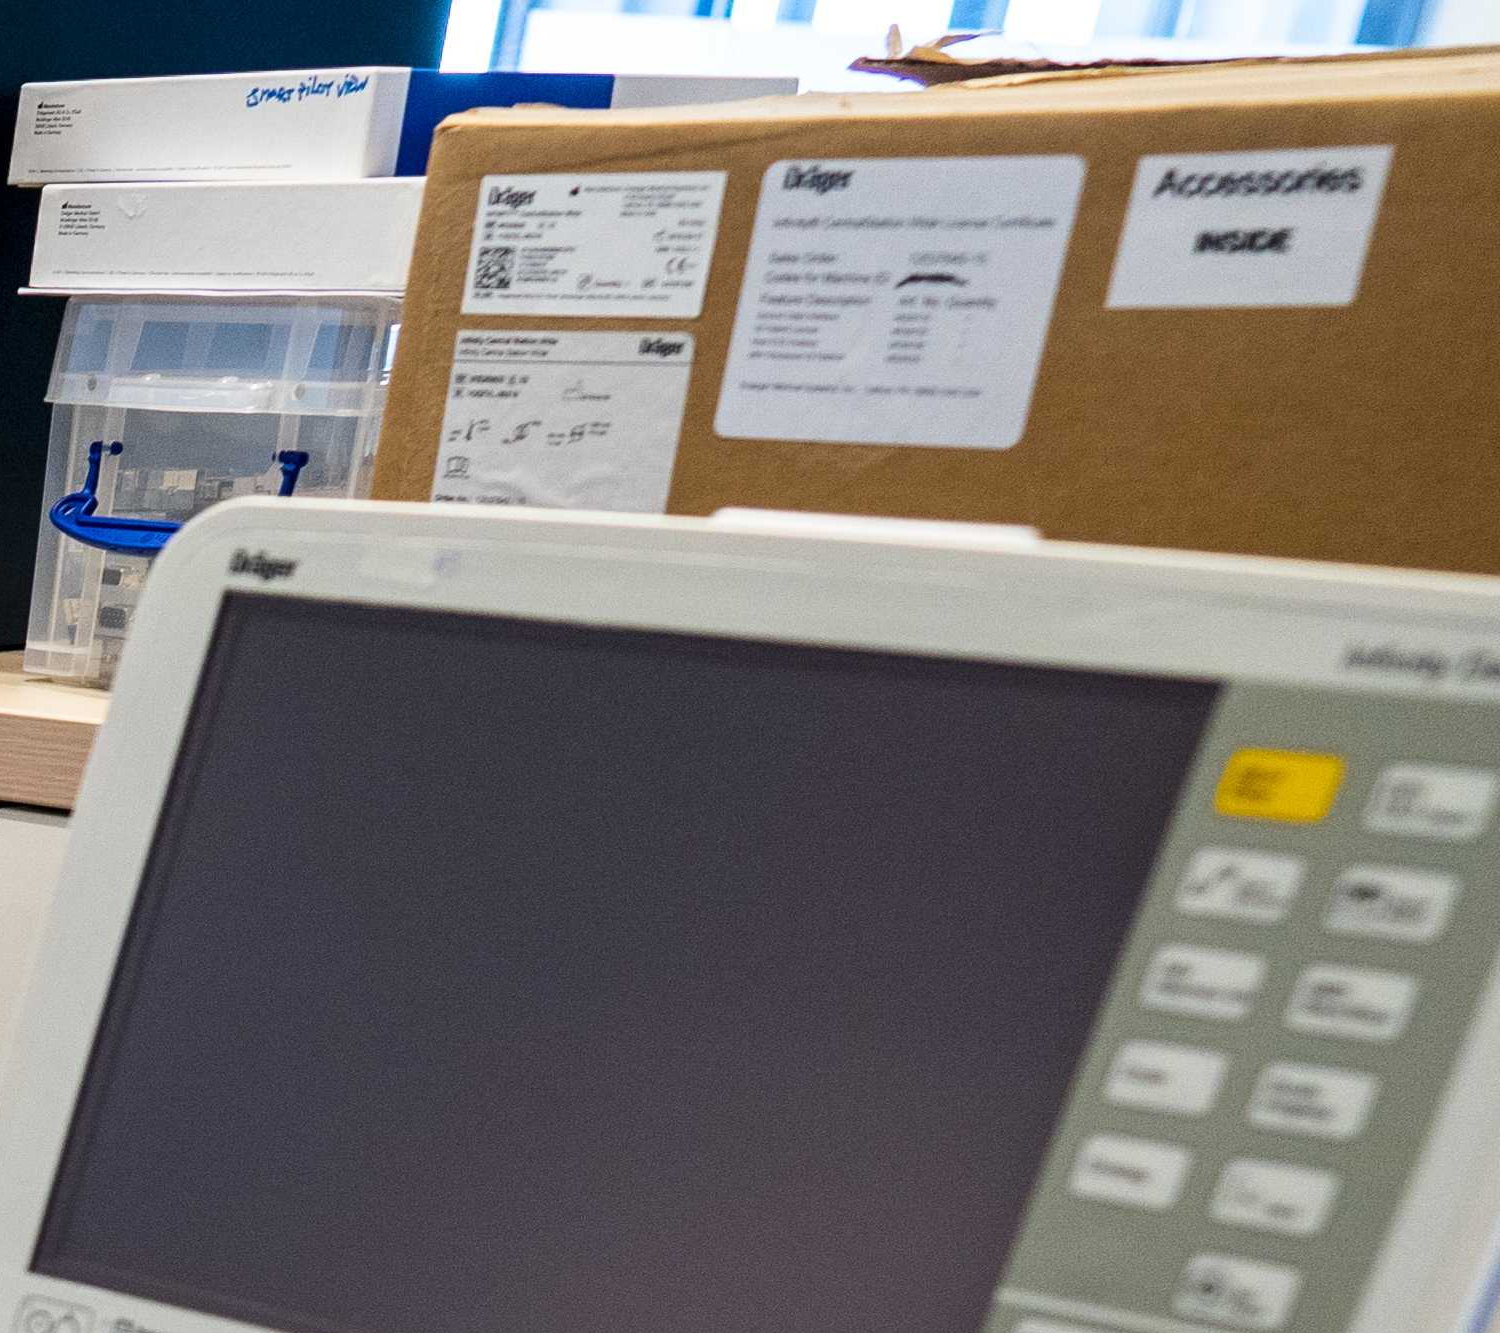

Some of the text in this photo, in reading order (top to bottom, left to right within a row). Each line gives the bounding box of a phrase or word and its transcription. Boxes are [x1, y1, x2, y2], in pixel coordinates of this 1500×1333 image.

[783, 165, 854, 194] Dräger
[1153, 166, 1363, 198] Accessories
[487, 186, 537, 209] Dräger
[1194, 227, 1293, 253] INSIDE
[228, 548, 298, 580] Dräger
